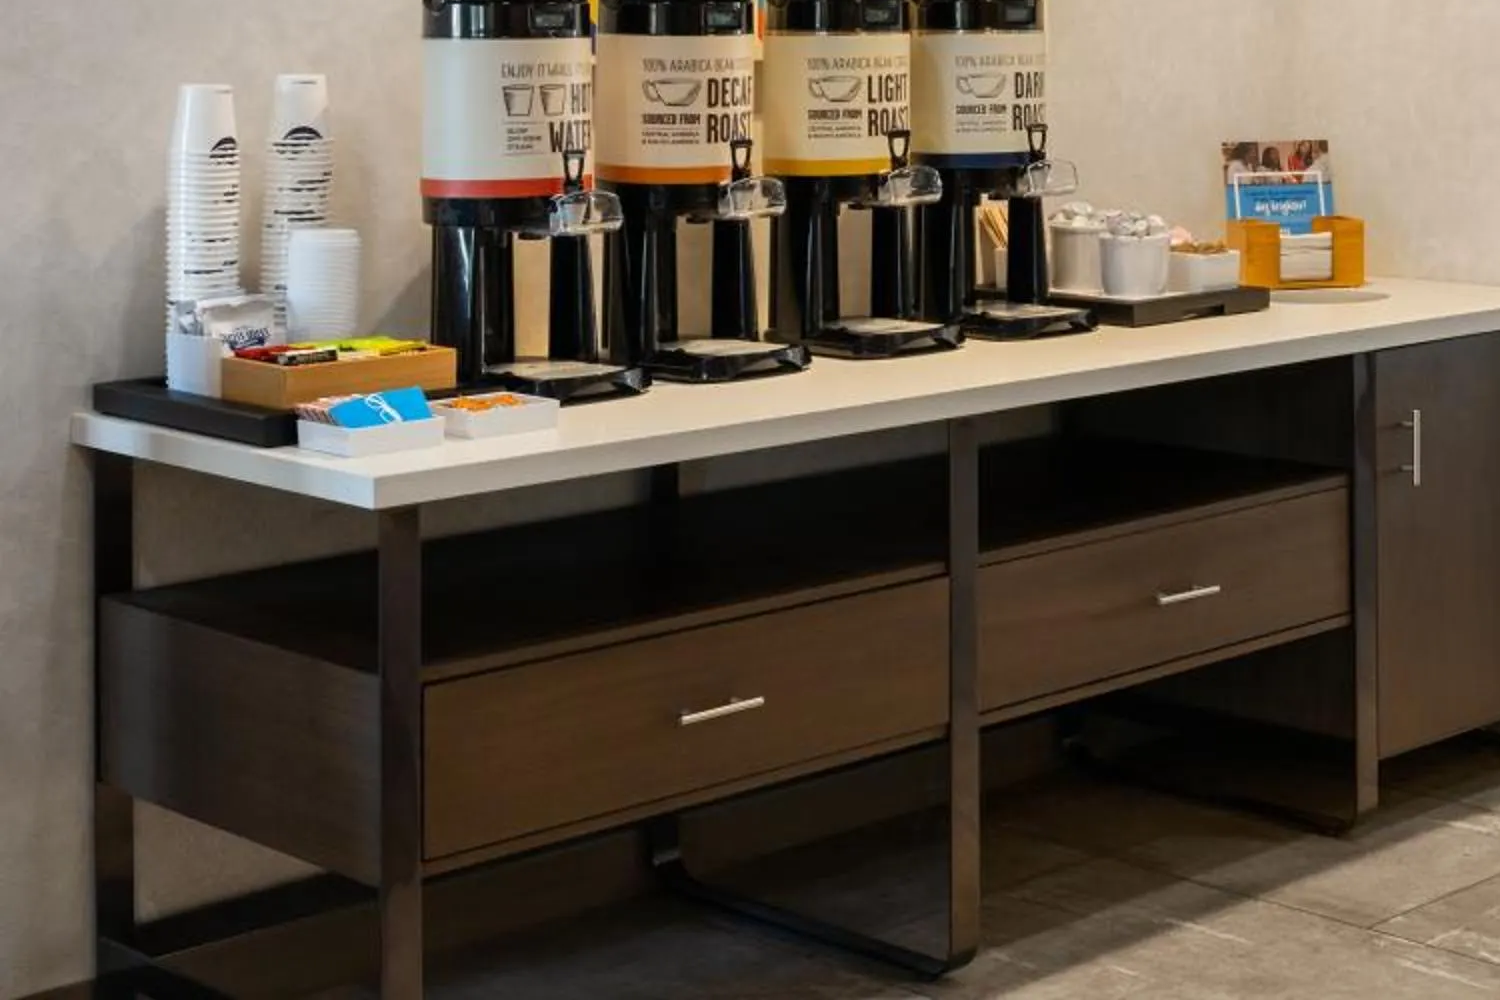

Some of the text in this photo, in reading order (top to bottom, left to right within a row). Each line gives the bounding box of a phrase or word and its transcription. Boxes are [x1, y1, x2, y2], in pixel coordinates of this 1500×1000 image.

[707, 76, 752, 108] DECAF
[867, 73, 908, 103] LIGHT
[706, 111, 752, 144] ROAST
[1012, 103, 1045, 131] ROAS
